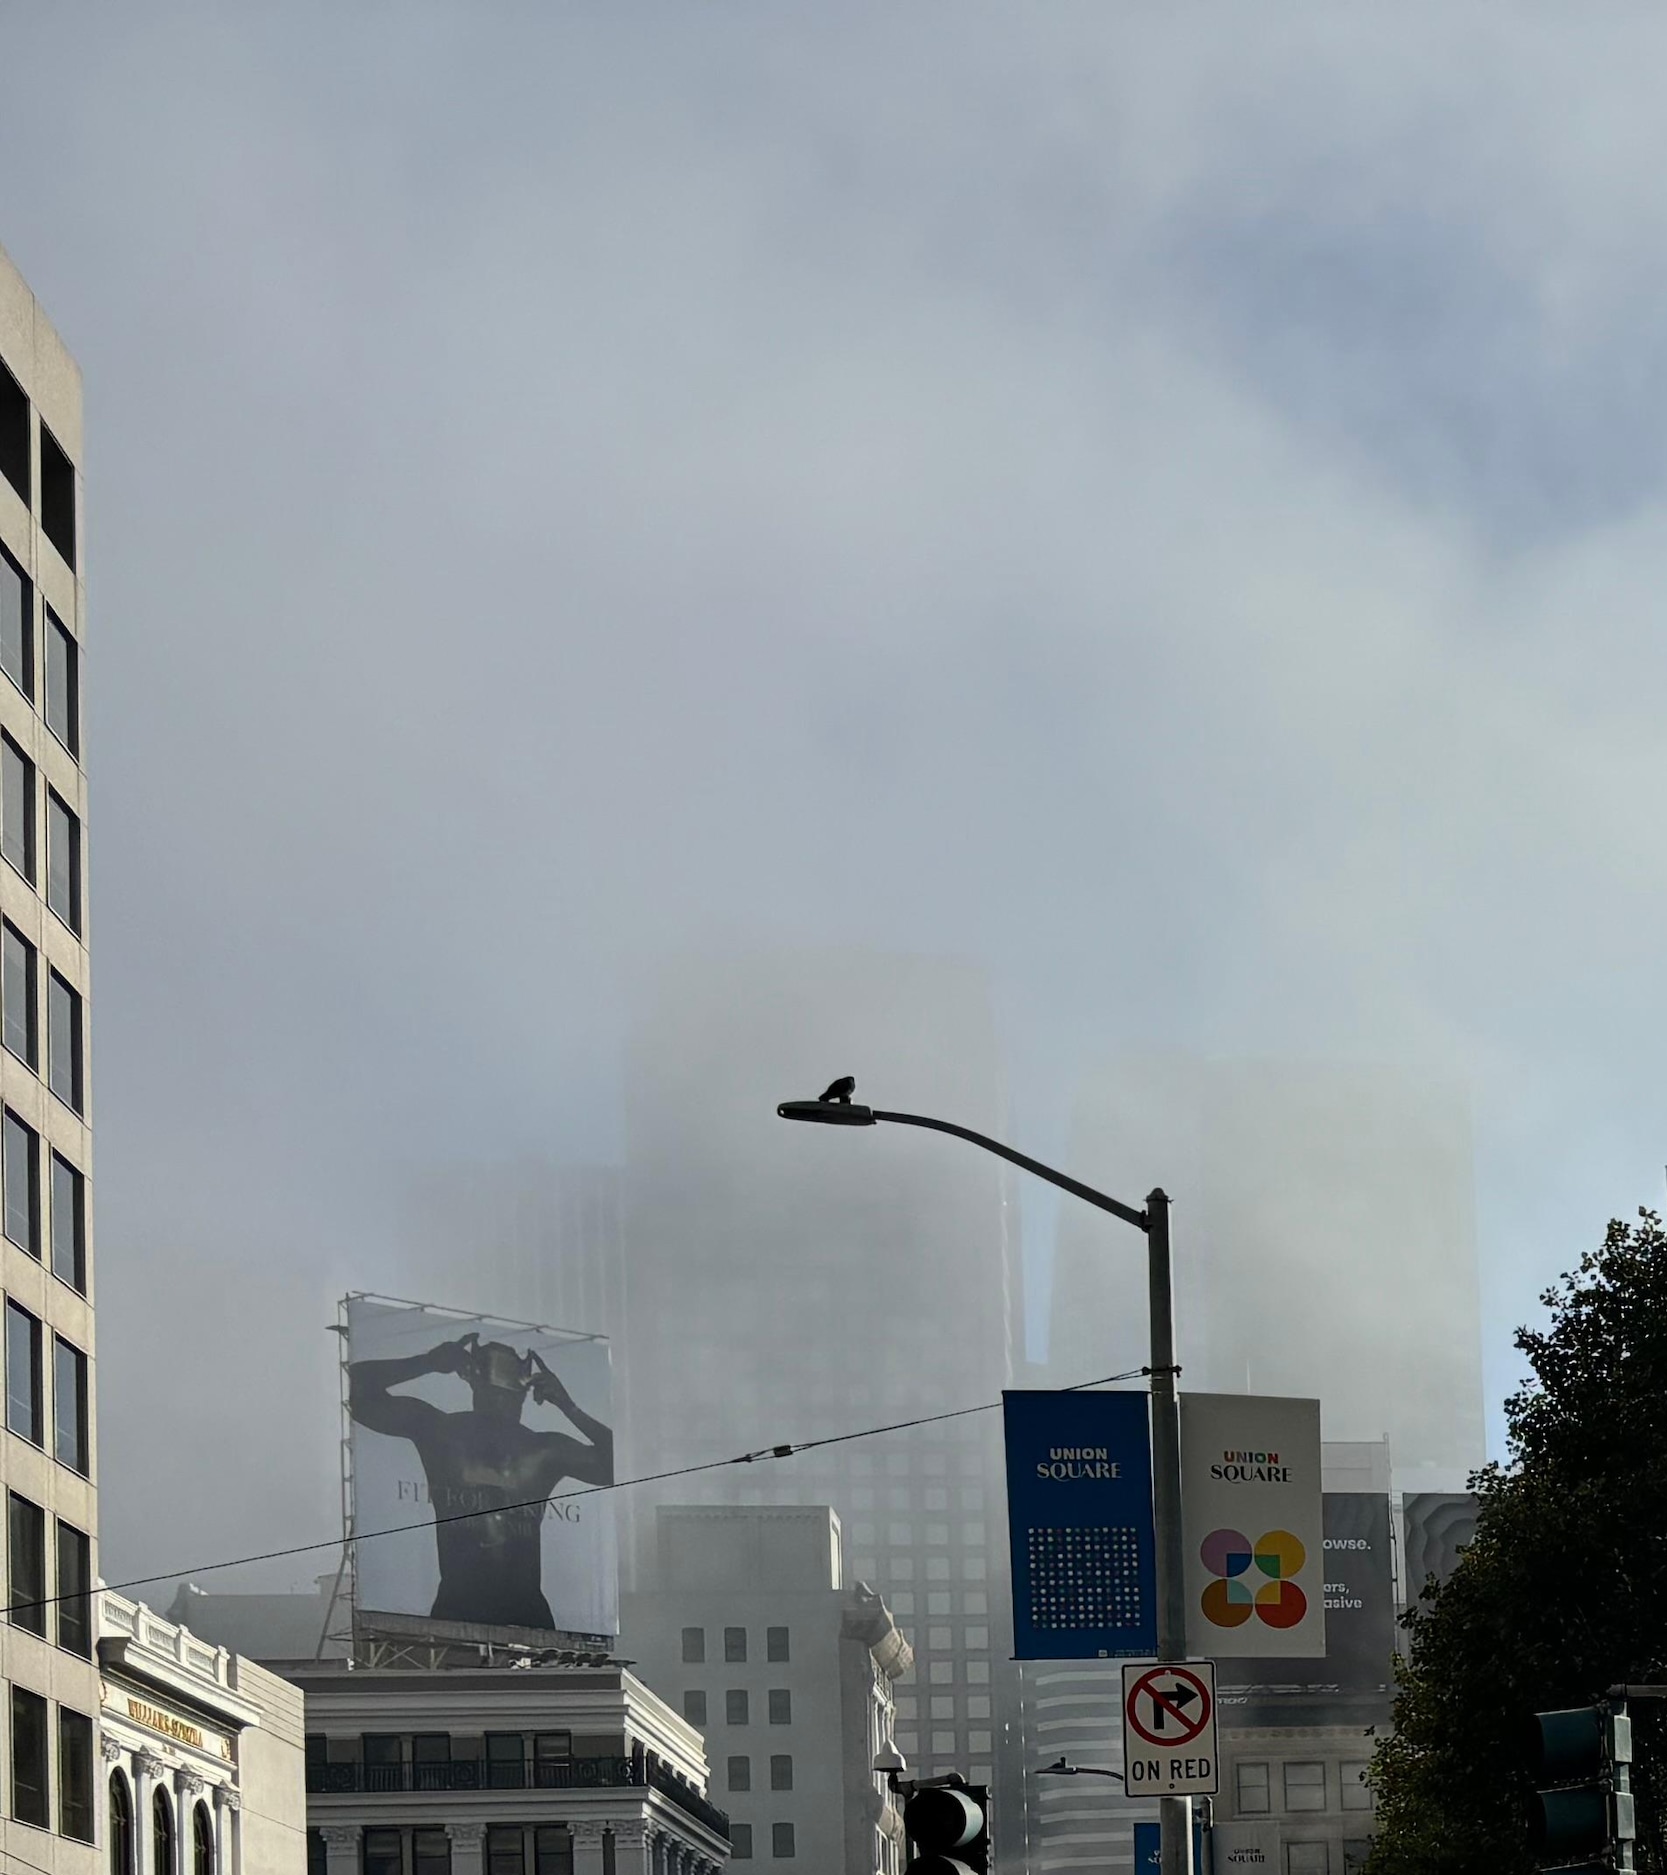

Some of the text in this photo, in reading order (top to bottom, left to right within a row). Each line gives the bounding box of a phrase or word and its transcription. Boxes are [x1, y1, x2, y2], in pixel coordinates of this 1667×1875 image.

[1049, 1447, 1108, 1460] UNION
[1224, 1451, 1279, 1464] UNION
[1036, 1462, 1122, 1481] SQUARE
[1210, 1464, 1293, 1484] SQUARE
[1323, 1539, 1372, 1550] owse.
[1323, 1595, 1362, 1608] asive
[1132, 1757, 1211, 1782] ON RED
